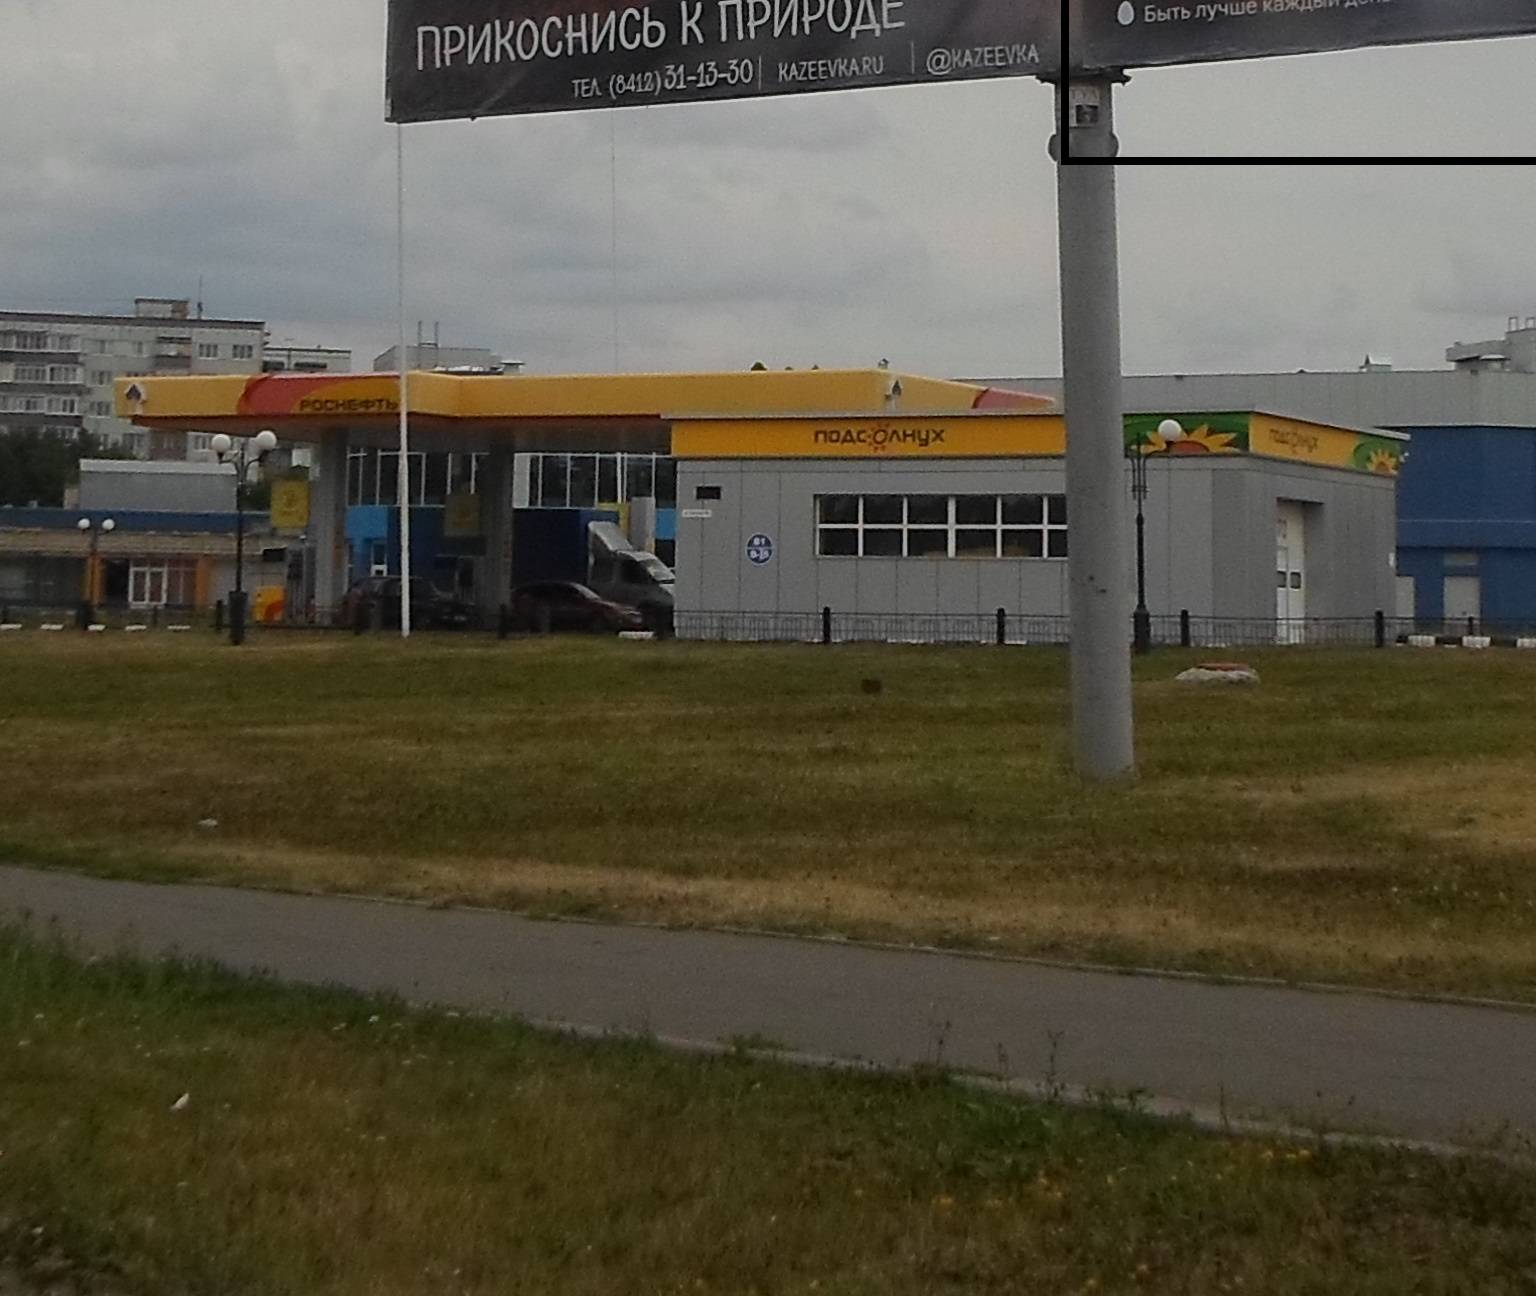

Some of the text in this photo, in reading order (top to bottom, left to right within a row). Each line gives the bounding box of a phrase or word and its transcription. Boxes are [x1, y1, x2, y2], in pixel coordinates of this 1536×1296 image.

[1144, 4, 1191, 24] Быть
[1195, 0, 1258, 22] лучше
[416, 6, 666, 71] ПРИКОСНИСЬ
[679, 0, 705, 46] К
[777, 55, 884, 83] KAZEEVKA.RU
[926, 43, 1041, 76] @KAZEEVKA
[609, 70, 661, 100] (8412)
[664, 58, 754, 91] 31-13-30
[299, 398, 400, 412] РОСНЕФТЬ
[814, 424, 945, 450] ПОДСОЛНУХ
